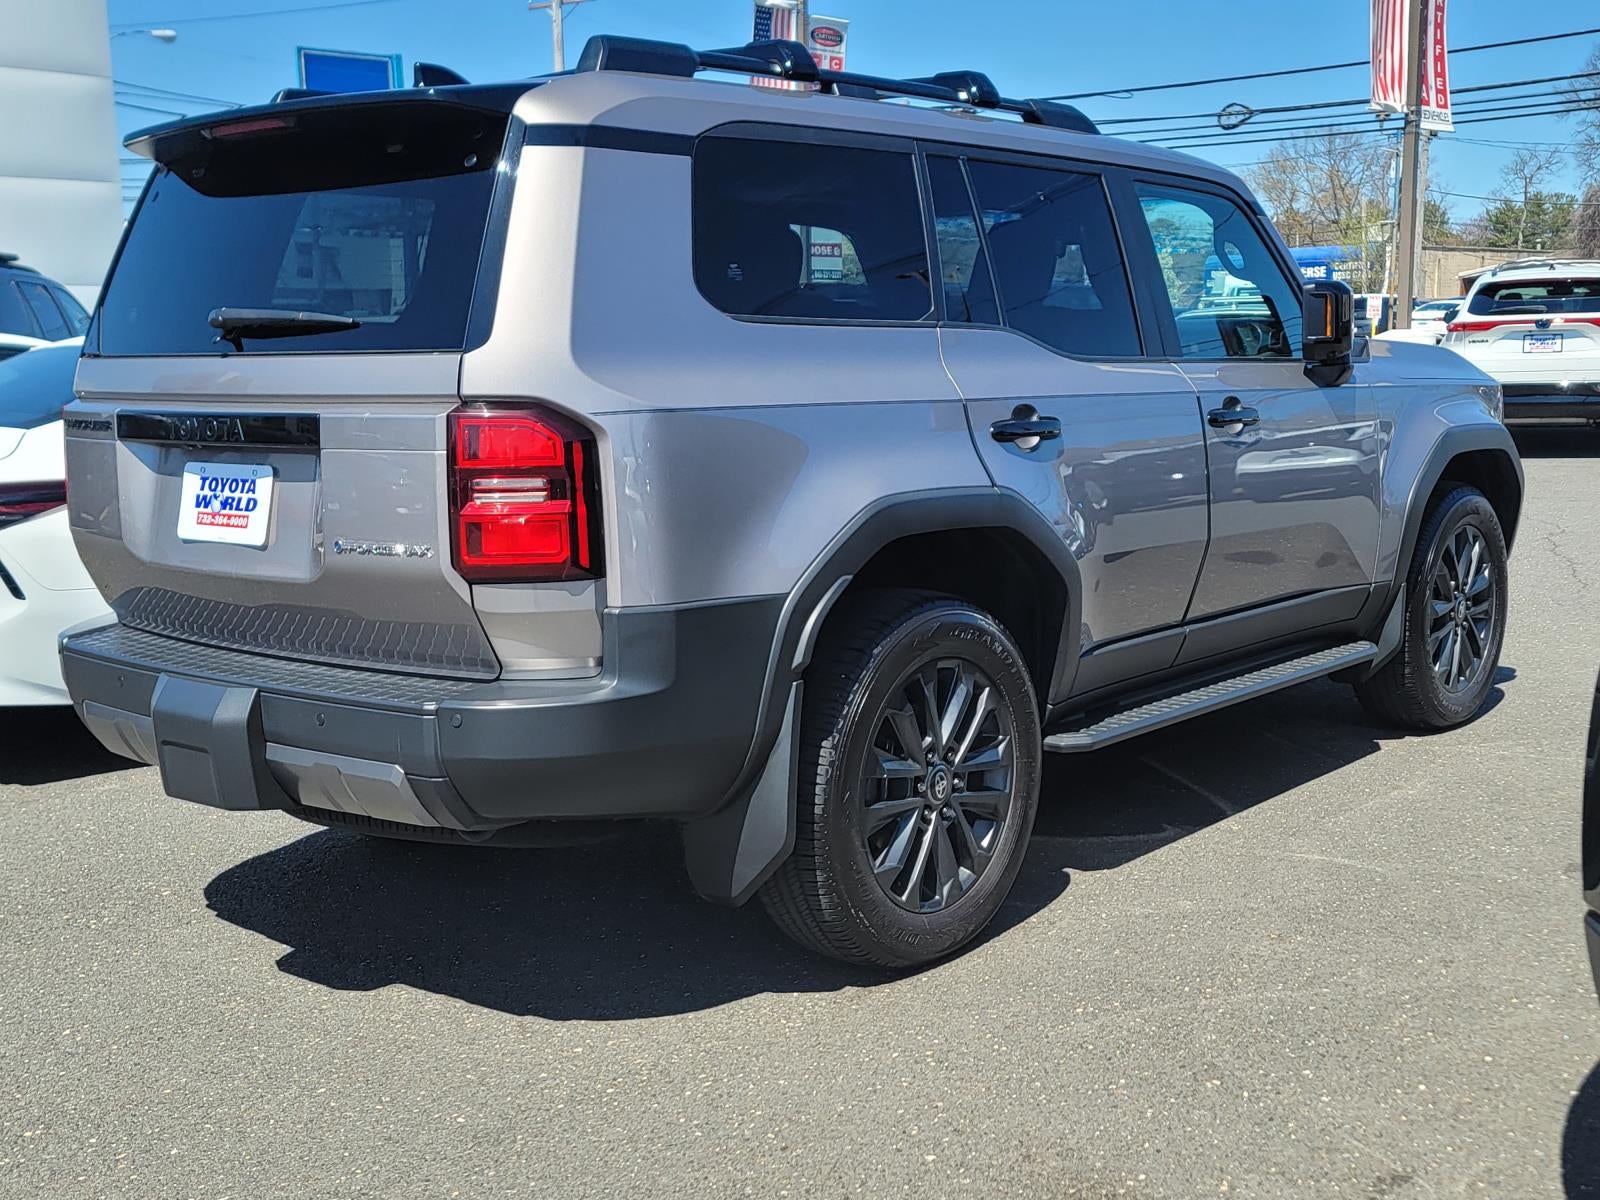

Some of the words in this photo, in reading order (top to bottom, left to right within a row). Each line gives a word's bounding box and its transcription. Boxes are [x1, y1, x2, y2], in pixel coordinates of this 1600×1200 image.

[168, 416, 245, 441] TOYOTA
[199, 476, 257, 495] TOYOTA
[194, 493, 258, 512] WORLD
[197, 513, 249, 527] 732-364-9000
